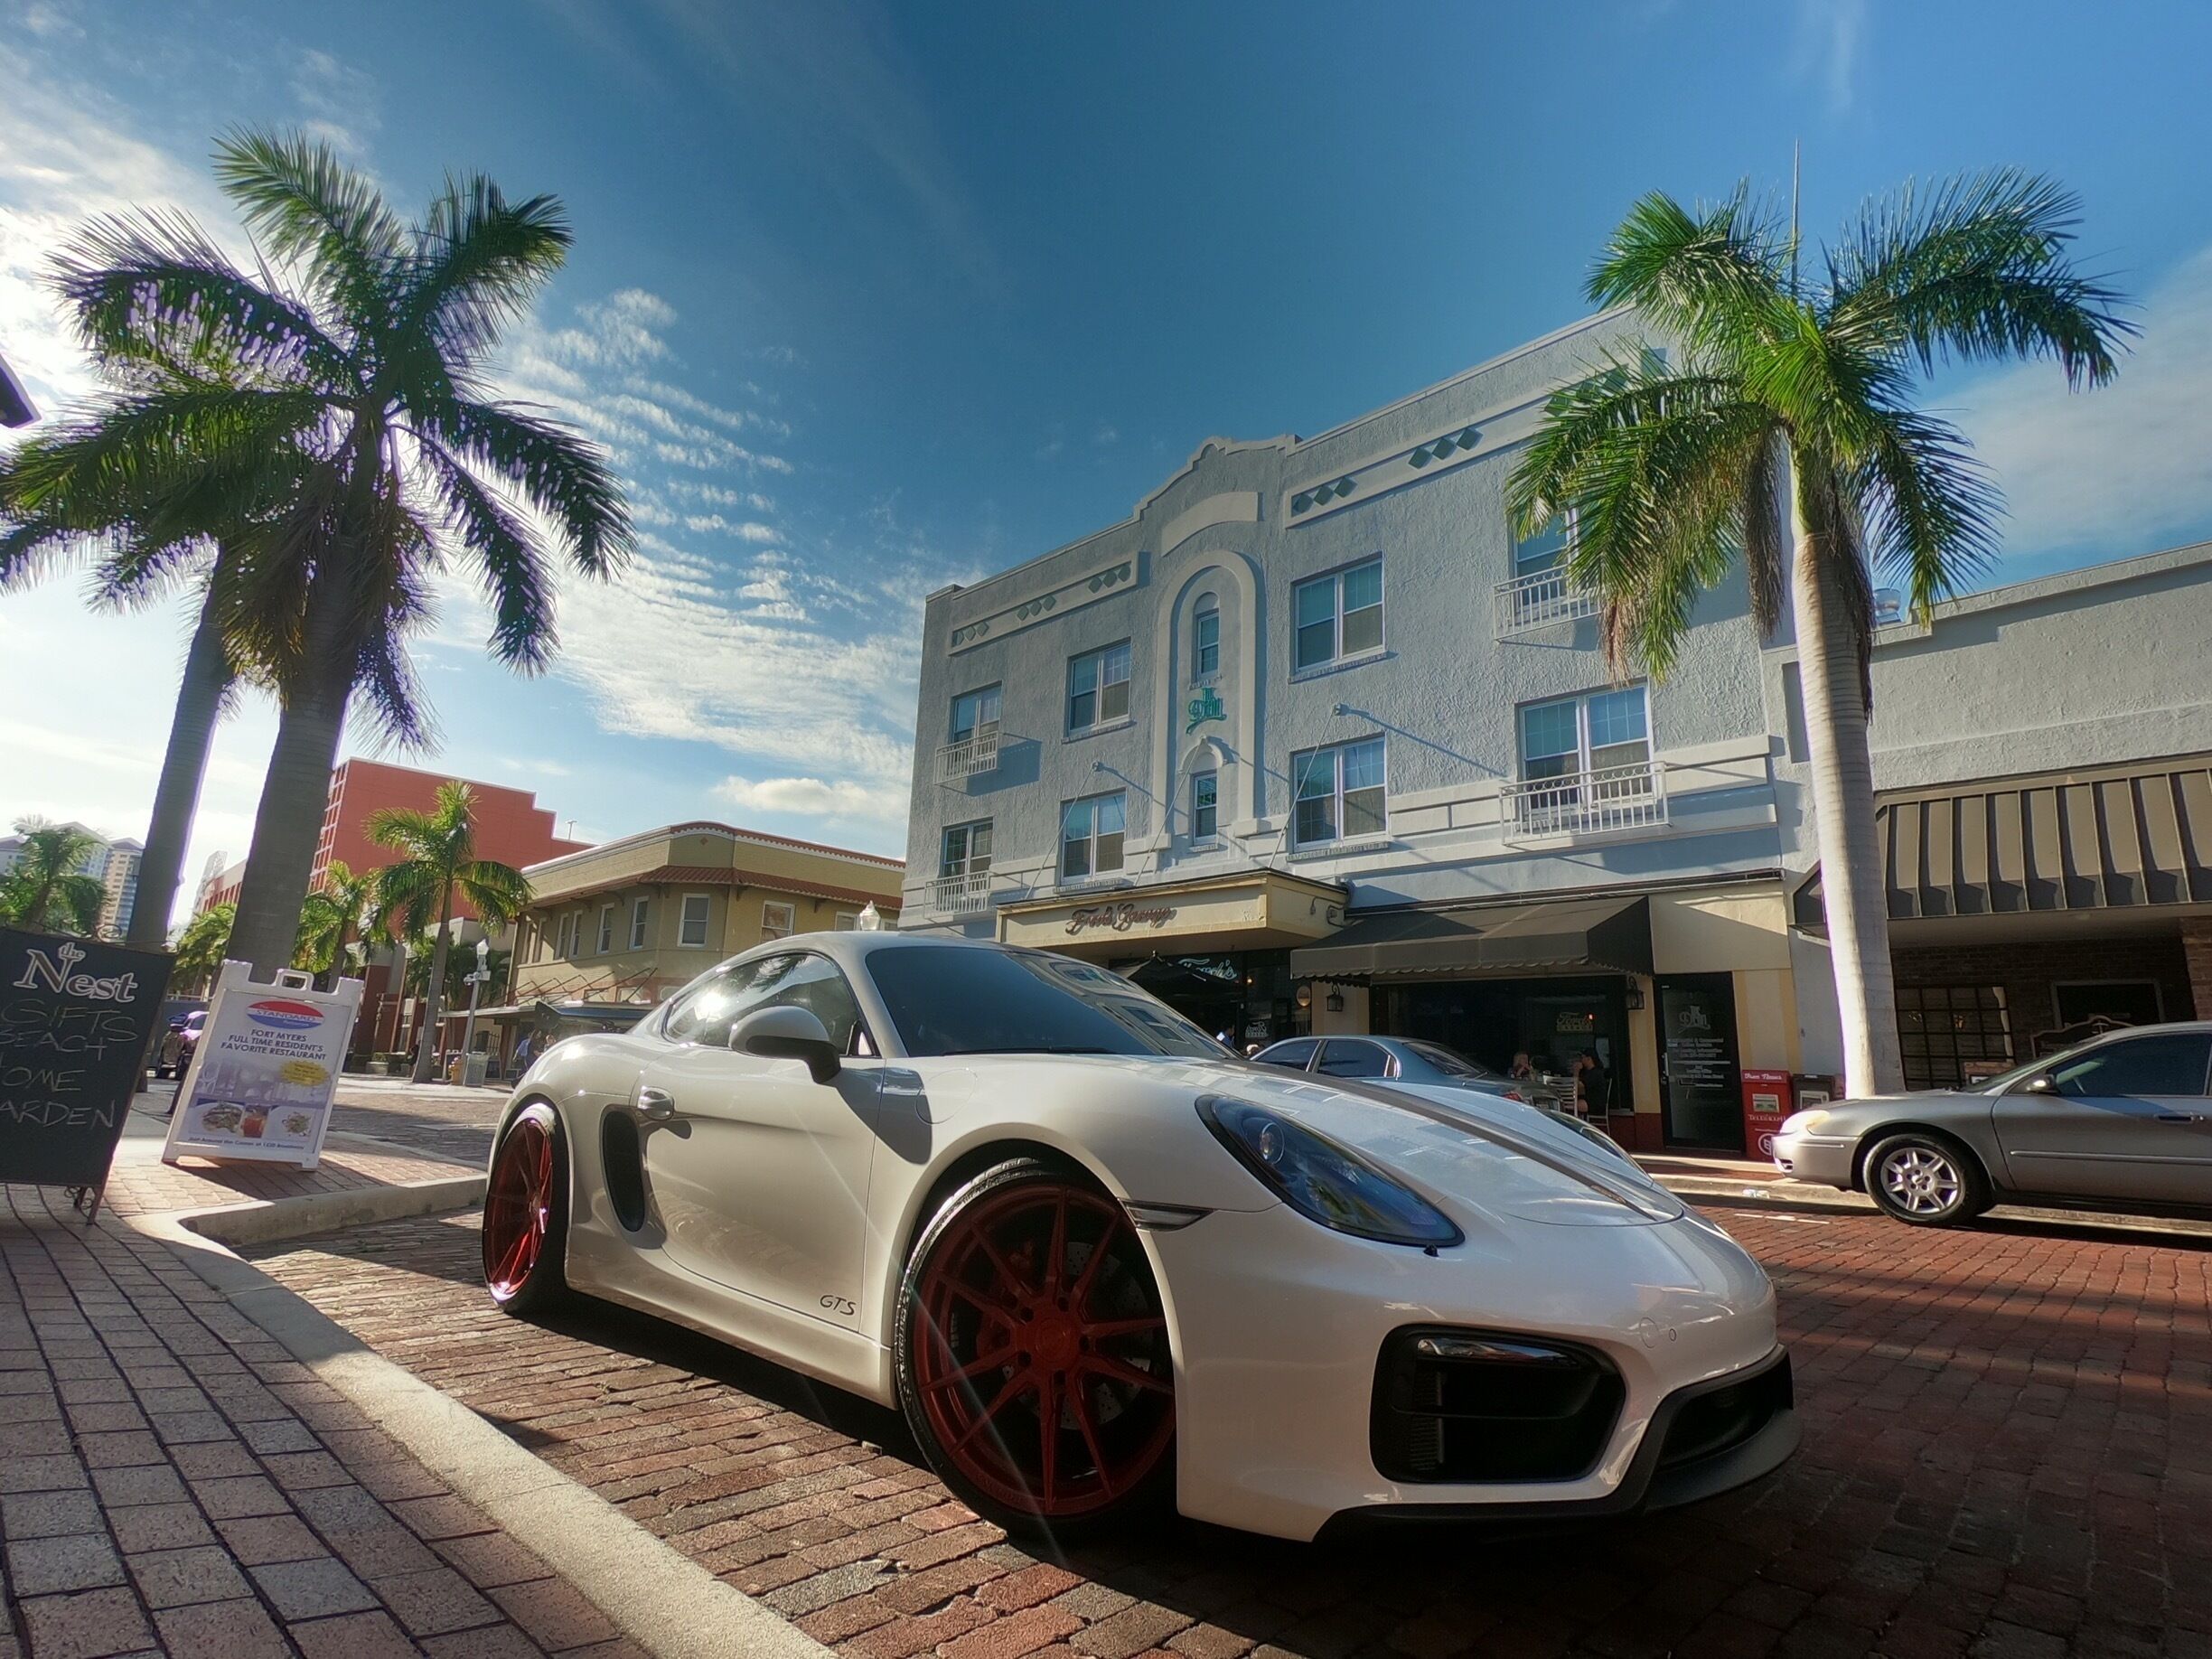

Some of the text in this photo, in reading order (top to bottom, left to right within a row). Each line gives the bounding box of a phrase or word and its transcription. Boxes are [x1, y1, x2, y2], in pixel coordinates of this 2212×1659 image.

[59, 942, 86, 961] the
[13, 949, 137, 1003] Nest
[1, 998, 138, 1042] GIFTS
[228, 1034, 248, 1043] FULL
[252, 1036, 274, 1046] TIME
[250, 1029, 307, 1042] FORT MYERS
[220, 1041, 327, 1061] FAVORITE RESTAURANT
[820, 1295, 857, 1316] GTS
